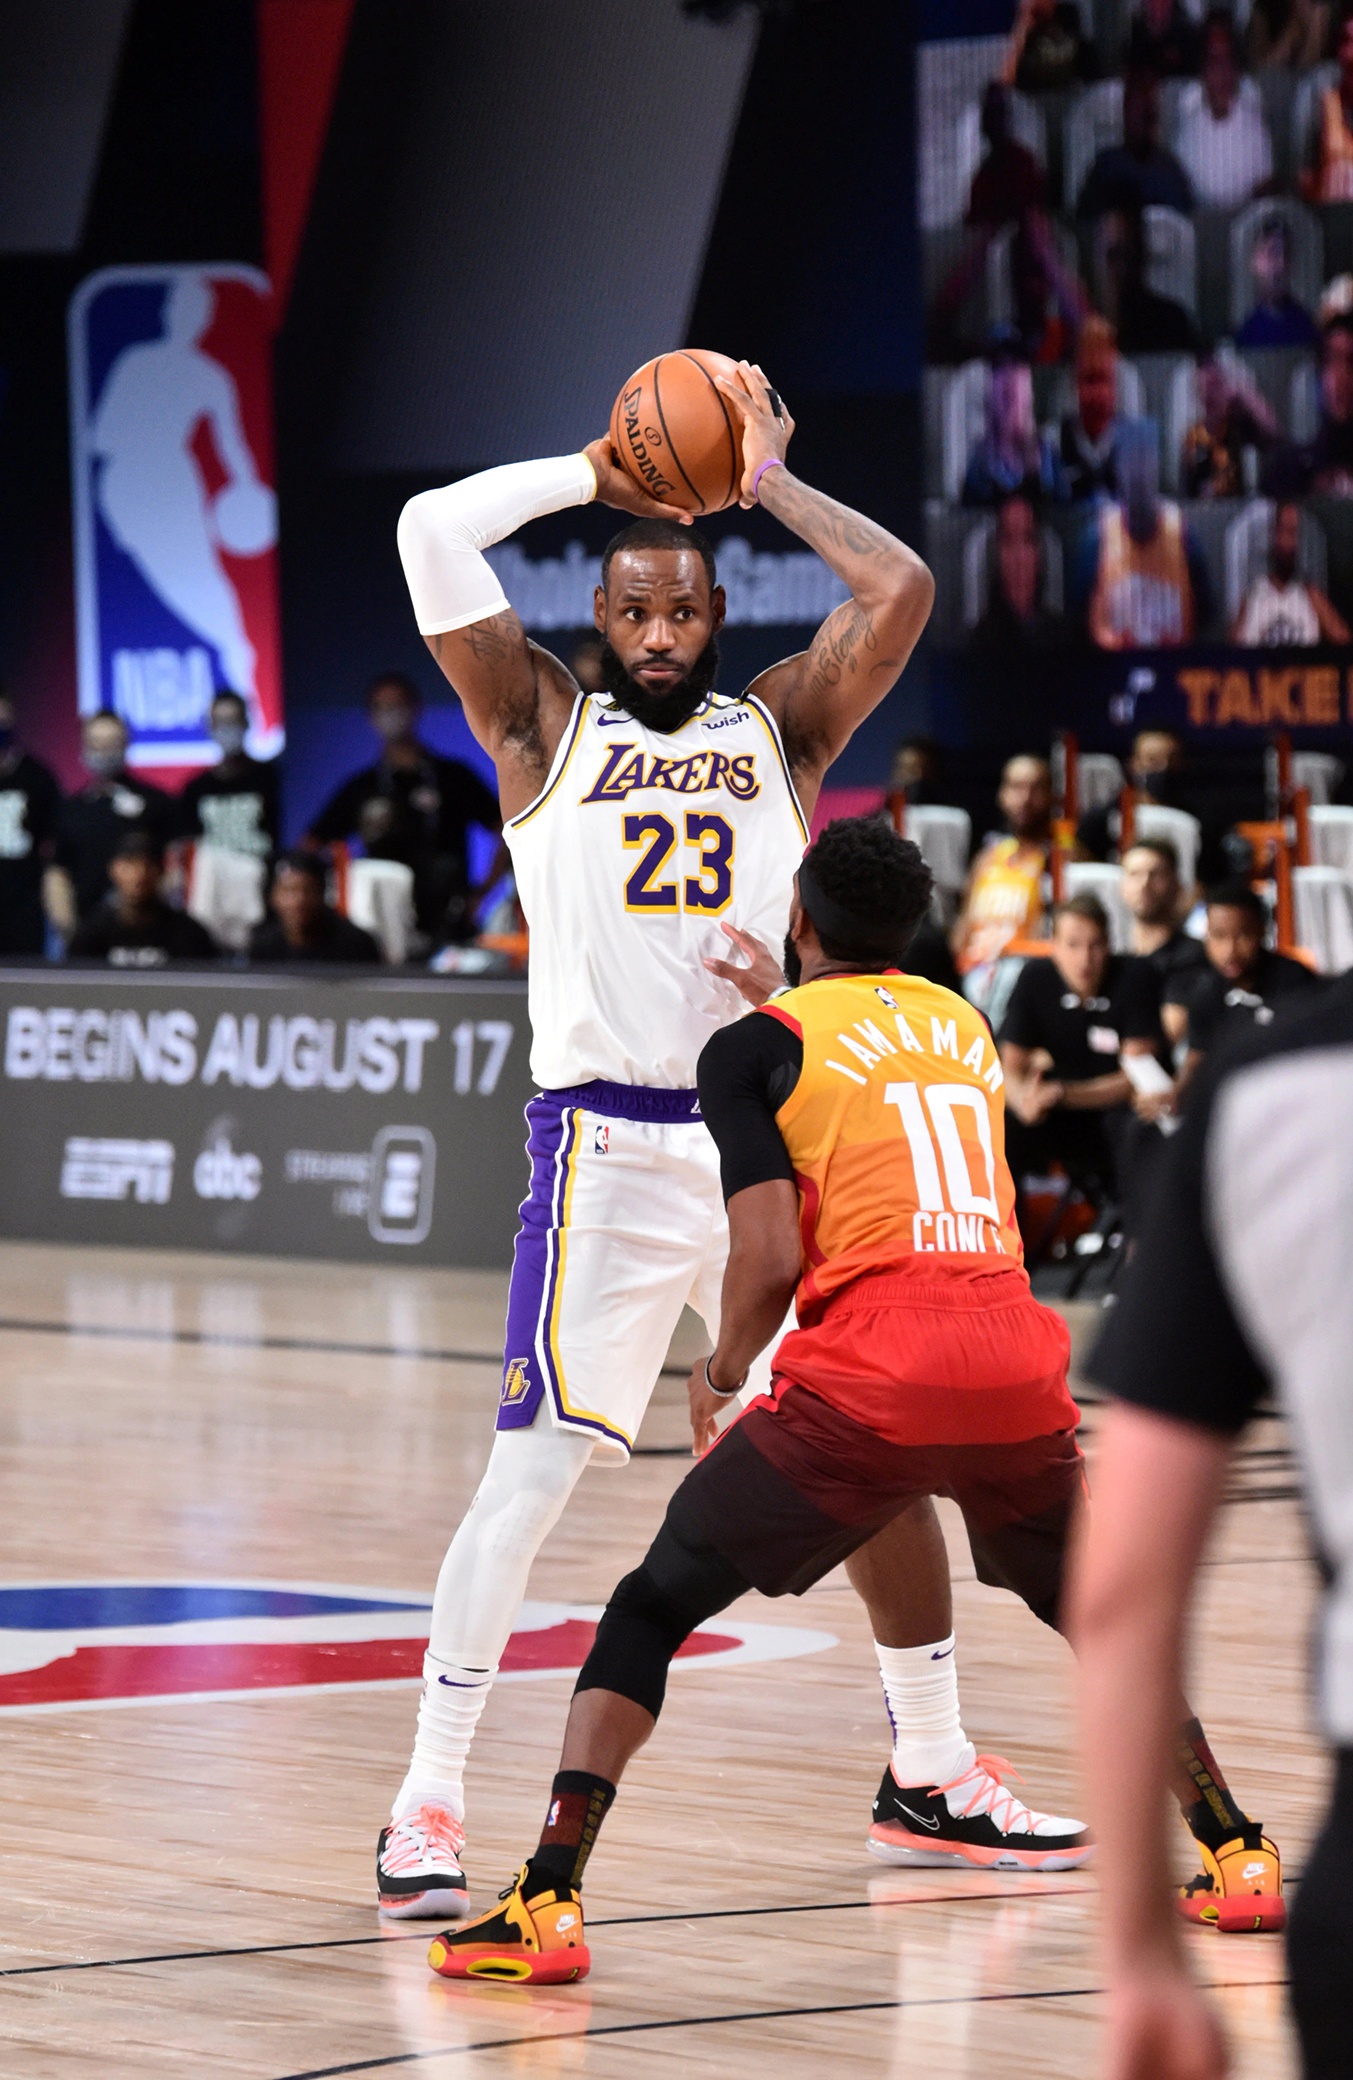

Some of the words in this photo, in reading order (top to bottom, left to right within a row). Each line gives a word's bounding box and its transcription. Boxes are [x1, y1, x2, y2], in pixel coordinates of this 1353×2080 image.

[624, 386, 677, 497] SPALDING
[701, 711, 750, 730] wish
[1177, 666, 1340, 726] TAKE
[578, 741, 763, 806] LAKERS
[621, 810, 737, 917] 23
[5, 1005, 199, 1086] BEGINS
[202, 1012, 440, 1095] AUGUST
[451, 1019, 514, 1096] 17
[59, 1135, 176, 1204] ESPN
[884, 1081, 1001, 1227] 10
